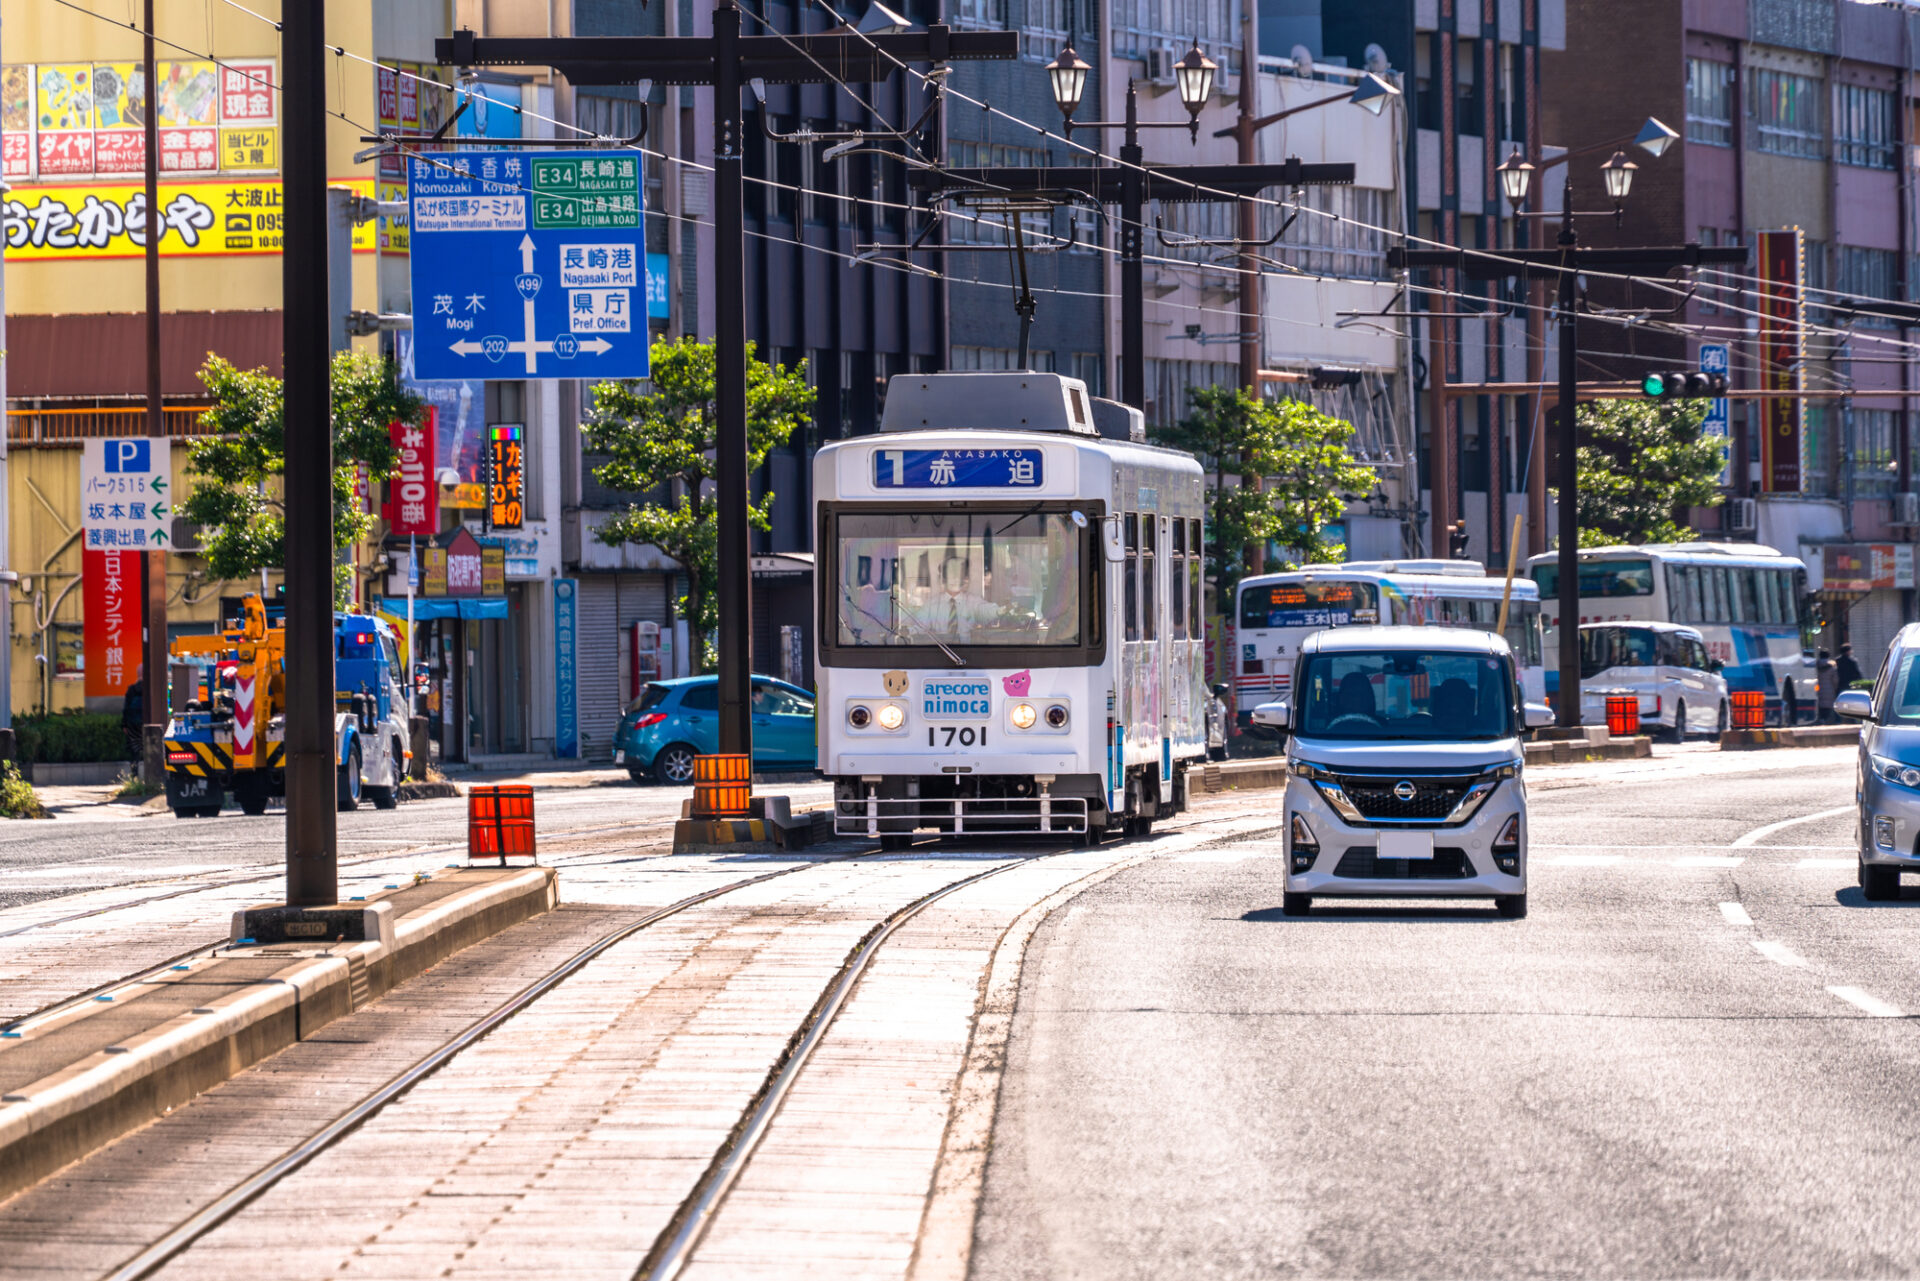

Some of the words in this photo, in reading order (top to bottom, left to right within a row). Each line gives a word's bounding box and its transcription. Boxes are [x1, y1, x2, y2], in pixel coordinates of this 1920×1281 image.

[226, 69, 268, 92] 即日
[226, 94, 269, 117] 現金
[41, 135, 92, 158] ダイヤ
[162, 131, 214, 149] 金券
[228, 134, 269, 148] 当ビル
[162, 152, 214, 169] 商品券
[234, 150, 264, 164] 3階
[482, 157, 522, 179] 香焼
[539, 168, 573, 184] E34
[580, 159, 634, 178] 長崎道
[414, 181, 472, 193] Nomozaki
[483, 182, 522, 195] Koyagi
[580, 180, 617, 190] NAGASAKI
[620, 180, 635, 189] EXP
[416, 199, 523, 217] 松が枝国際ターミナル
[540, 203, 575, 219] E34
[581, 196, 636, 214] 出島道路
[417, 218, 449, 230] Matsugae
[450, 218, 493, 228] International
[494, 217, 524, 228] Terminal
[581, 215, 611, 226] DEJIMA
[613, 214, 636, 225] ROAD
[564, 248, 632, 269] 長崎港
[519, 279, 539, 290] 499
[564, 273, 610, 285] Nagasaki
[612, 272, 633, 284] Port
[433, 293, 486, 315] 茂木
[573, 293, 626, 315] 県庁
[446, 317, 474, 332] Mogi
[597, 318, 626, 330] Office
[485, 341, 504, 352] 202
[558, 341, 574, 352] 112
[118, 441, 138, 472] P
[942, 450, 1022, 459] AKASAKO
[884, 450, 904, 485] 1
[929, 458, 1035, 485] 赤迫
[87, 476, 145, 495] パーク515
[506, 441, 522, 526] カギの
[88, 502, 147, 520] 坂本屋
[104, 550, 124, 686] 日本シティ銀行
[924, 683, 989, 696] arecore
[924, 697, 989, 713] nimoca
[928, 726, 987, 747] 1701
